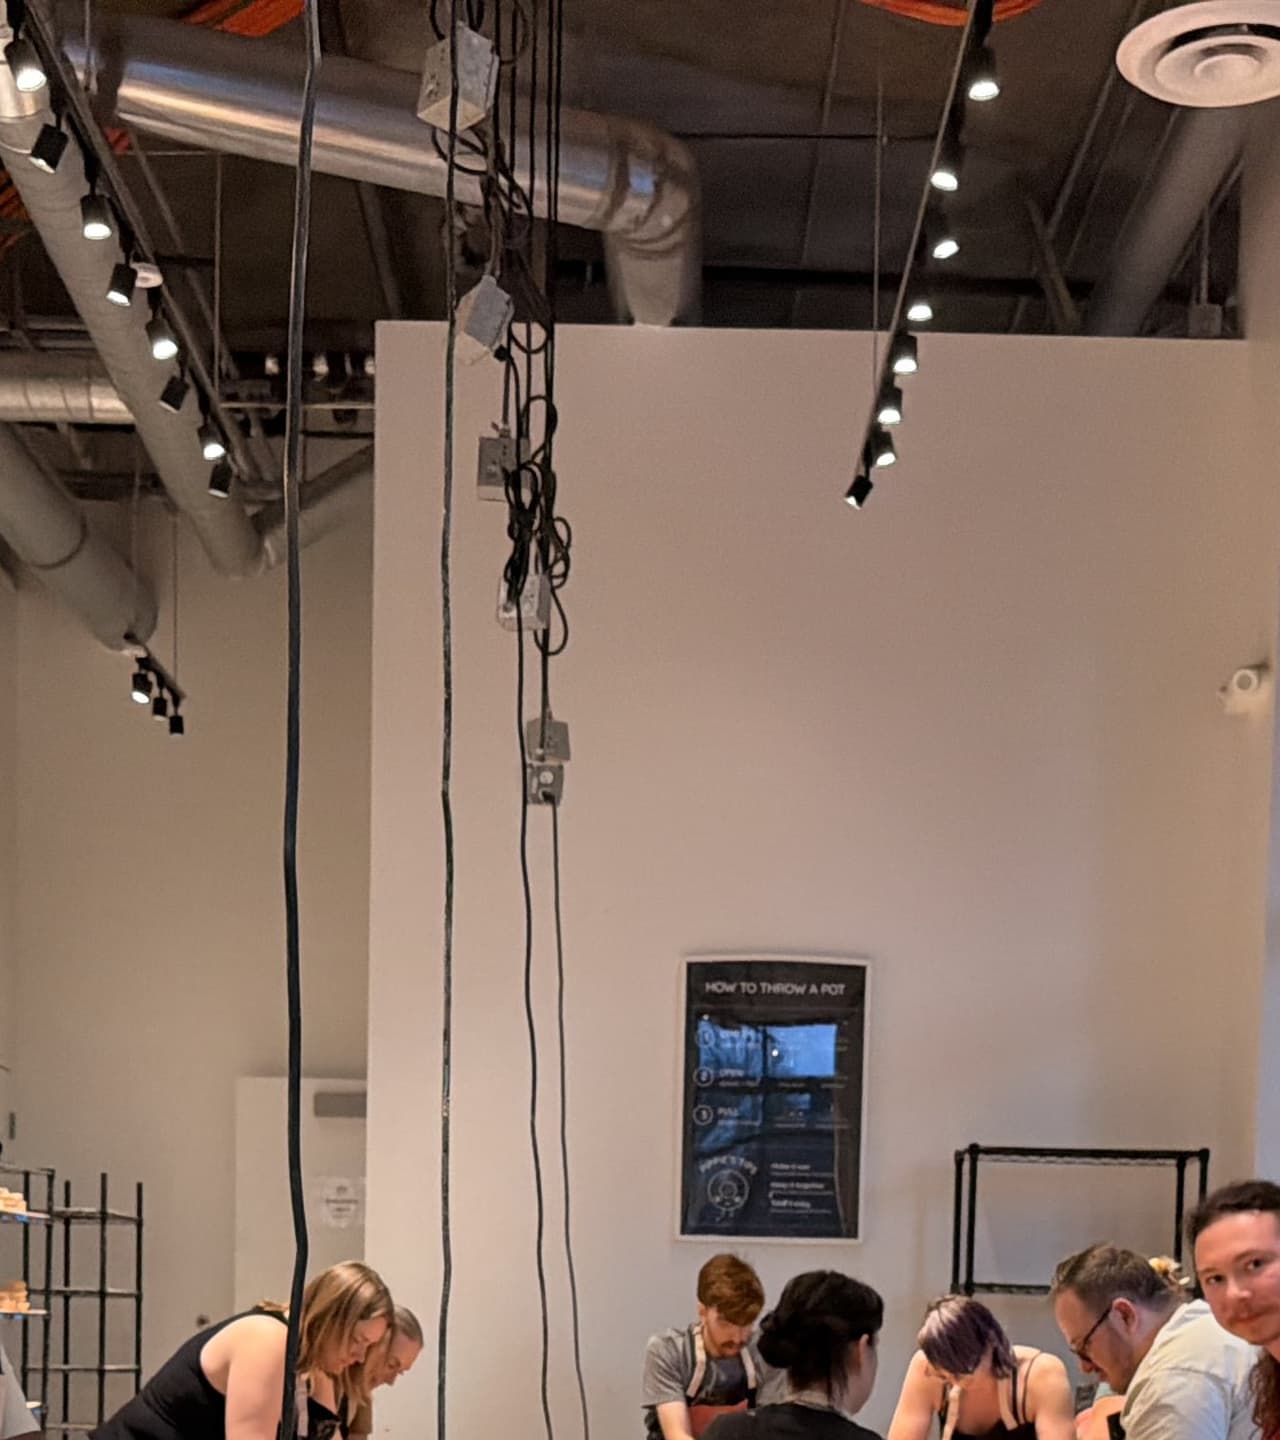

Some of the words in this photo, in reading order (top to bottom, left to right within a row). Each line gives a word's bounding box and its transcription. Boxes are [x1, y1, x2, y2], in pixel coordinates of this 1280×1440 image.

[705, 981, 736, 993] HOW
[740, 981, 757, 994] TO
[759, 982, 806, 995] THROW
[809, 983, 818, 995] A
[821, 983, 845, 995] POT
